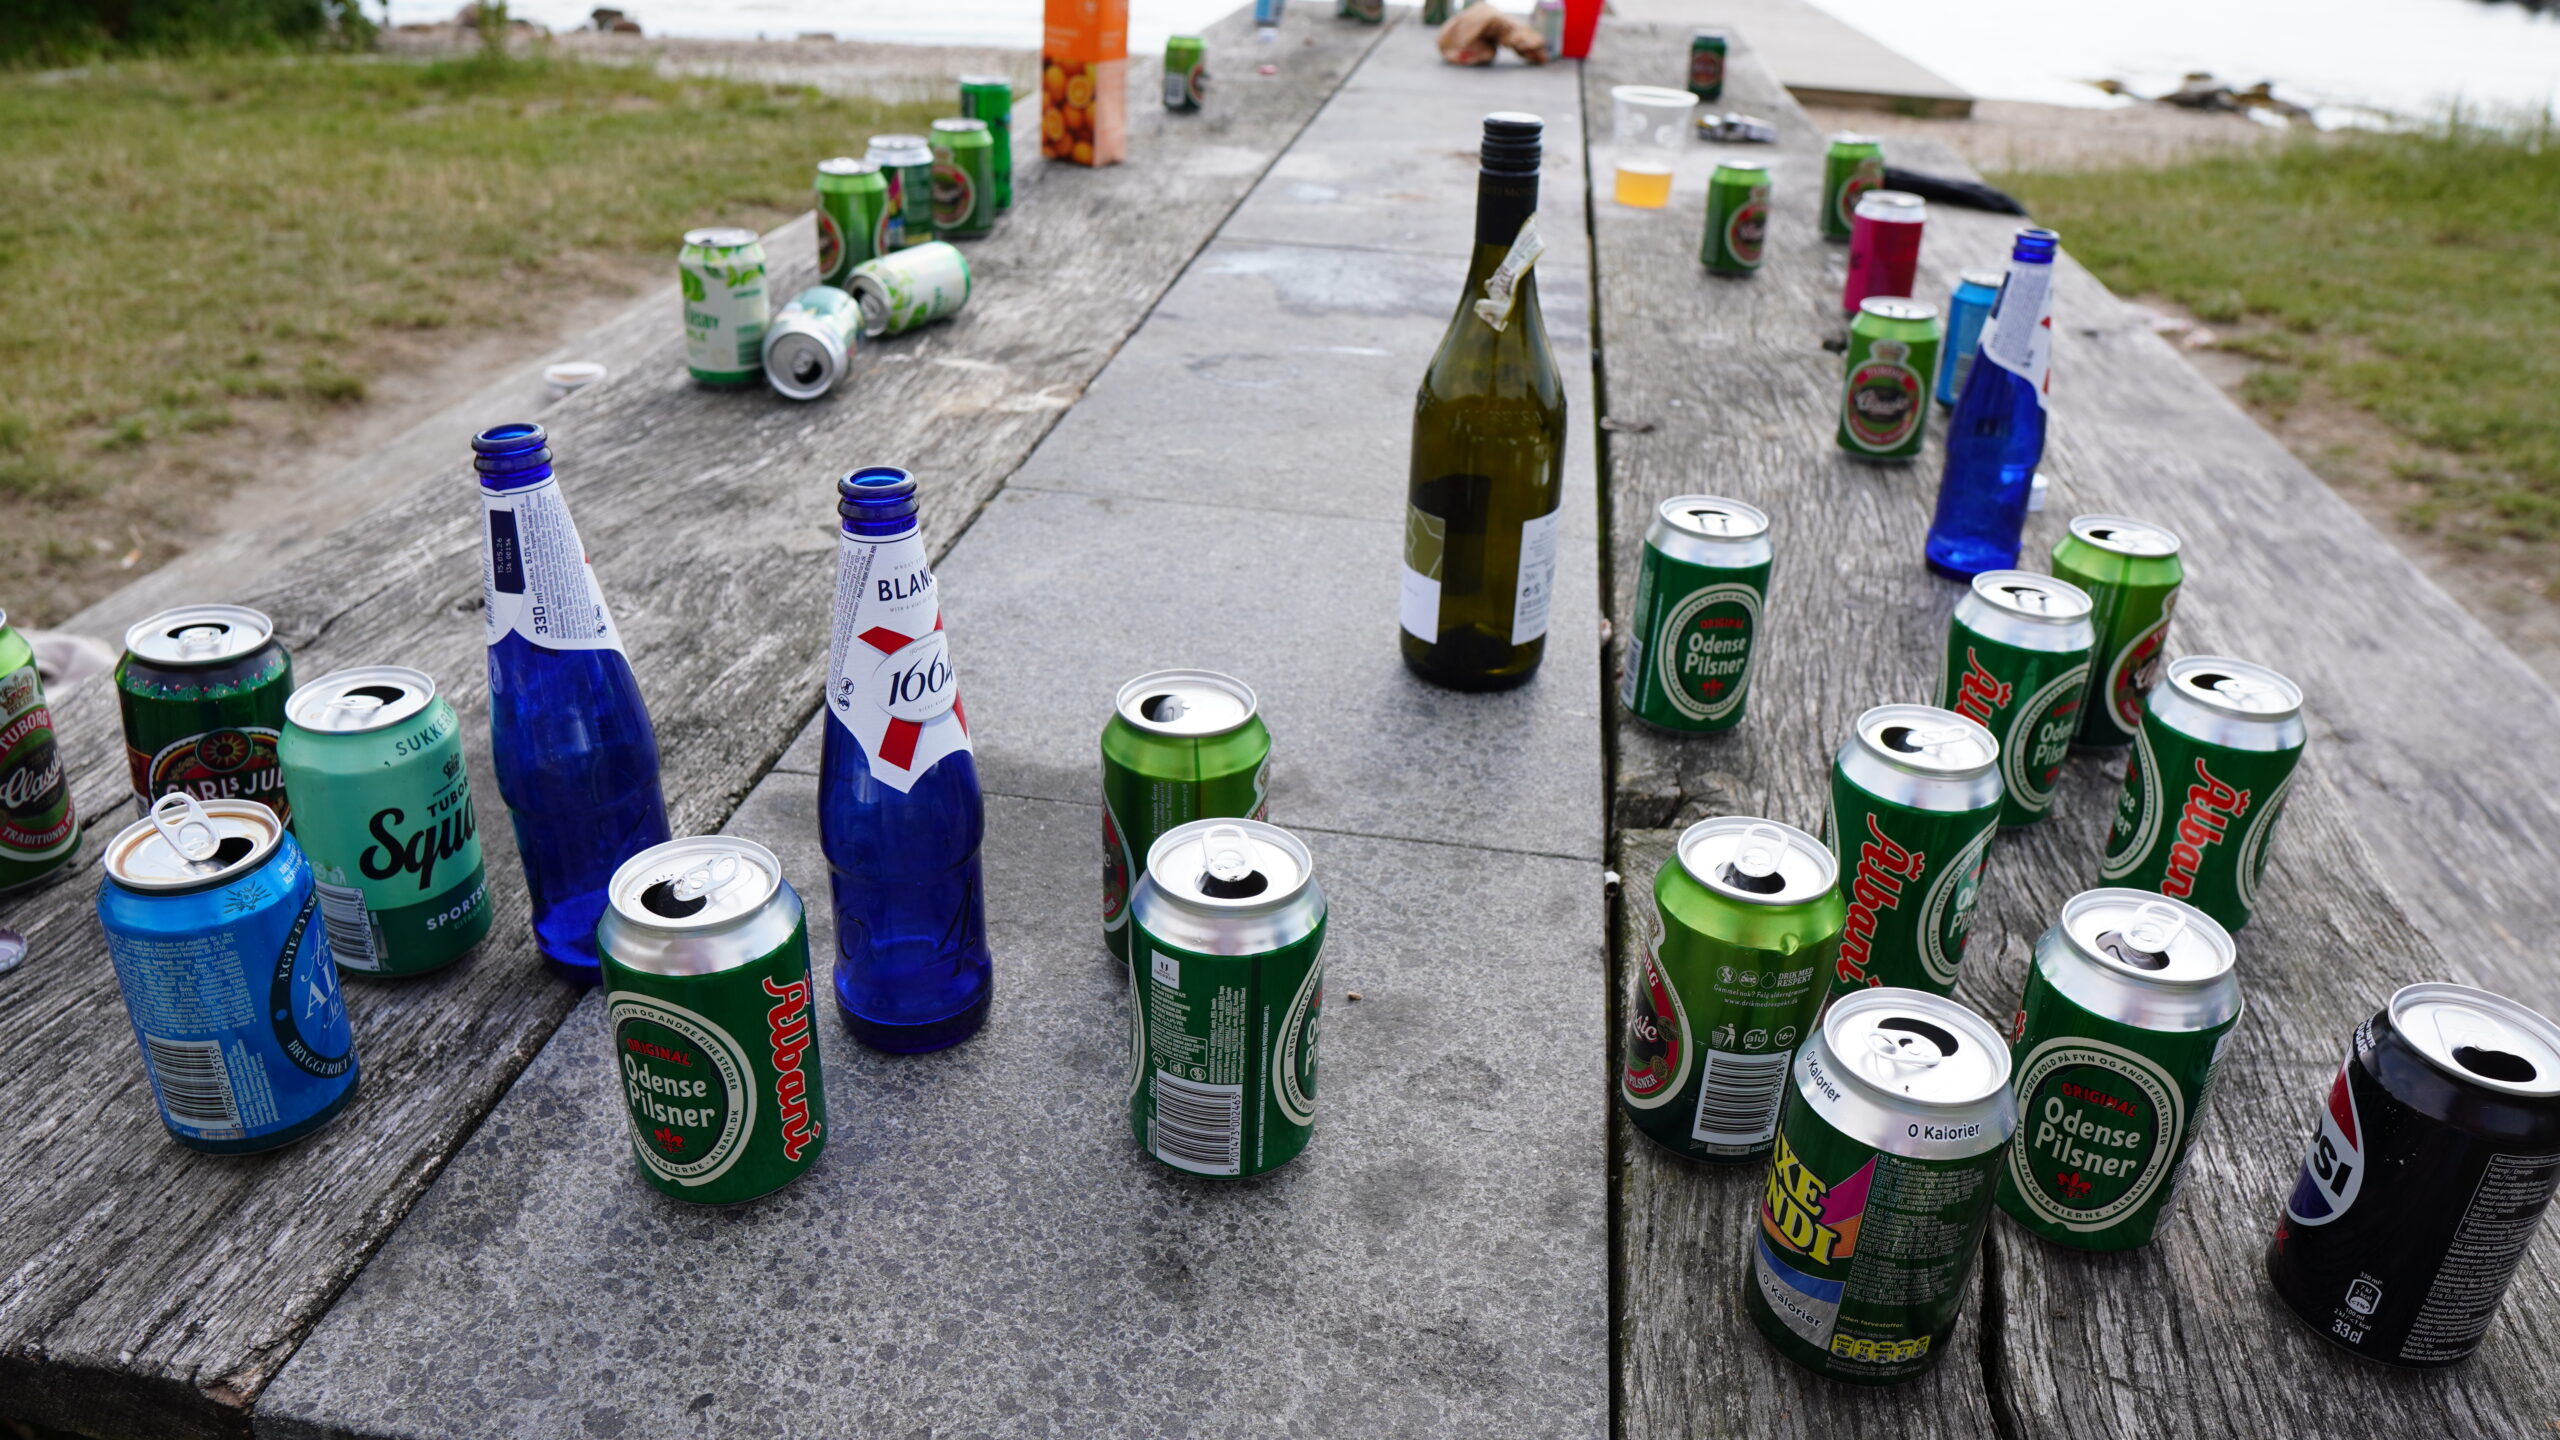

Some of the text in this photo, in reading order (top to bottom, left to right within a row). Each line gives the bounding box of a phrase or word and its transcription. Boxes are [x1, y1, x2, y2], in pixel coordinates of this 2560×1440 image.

[532, 592, 549, 635] 330 ml
[1688, 631, 1747, 654] Odense
[889, 649, 953, 706] 1664
[1684, 652, 1745, 676] Pilsner
[0, 709, 48, 751] TUBORG
[244, 766, 286, 796] JUL
[2, 823, 67, 846] TRADITIONEL
[1836, 812, 1911, 988] Albani
[1776, 974, 1813, 988] RESPEKT
[1778, 966, 1814, 980] DRIK MED
[287, 1039, 349, 1077] BRYGGERIET
[626, 1037, 693, 1066] ORIGINAL
[640, 1009, 655, 1019] OG
[658, 1015, 699, 1038] ANDRE
[698, 1036, 718, 1056] FINE
[717, 1055, 738, 1091] STEDER
[1746, 1032, 1793, 1043] alu 16+
[624, 1053, 707, 1098] Odense
[762, 972, 822, 1162] Albani
[1808, 1058, 1840, 1104] Kalorier
[628, 1079, 716, 1128] Pilsner
[2023, 1053, 2169, 1146] NYDES KOLD PÅ FYN OG ANDRE FINE STEDER
[2061, 1082, 2137, 1118] ORIGINAL
[711, 1109, 739, 1162] ALBANI.DK
[1229, 1094, 1241, 1162] 701473 002465
[1907, 1122, 1980, 1141] 0 Kalorier
[2044, 1096, 2141, 1149] Odense
[2034, 1121, 2137, 1178] Pilsner
[2021, 1163, 2103, 1219] BRYGGERIERNE
[2111, 1163, 2157, 1211] ALBANI.DK
[2360, 1291, 2373, 1301] kcal
[2359, 1321, 2372, 1330] kcal
